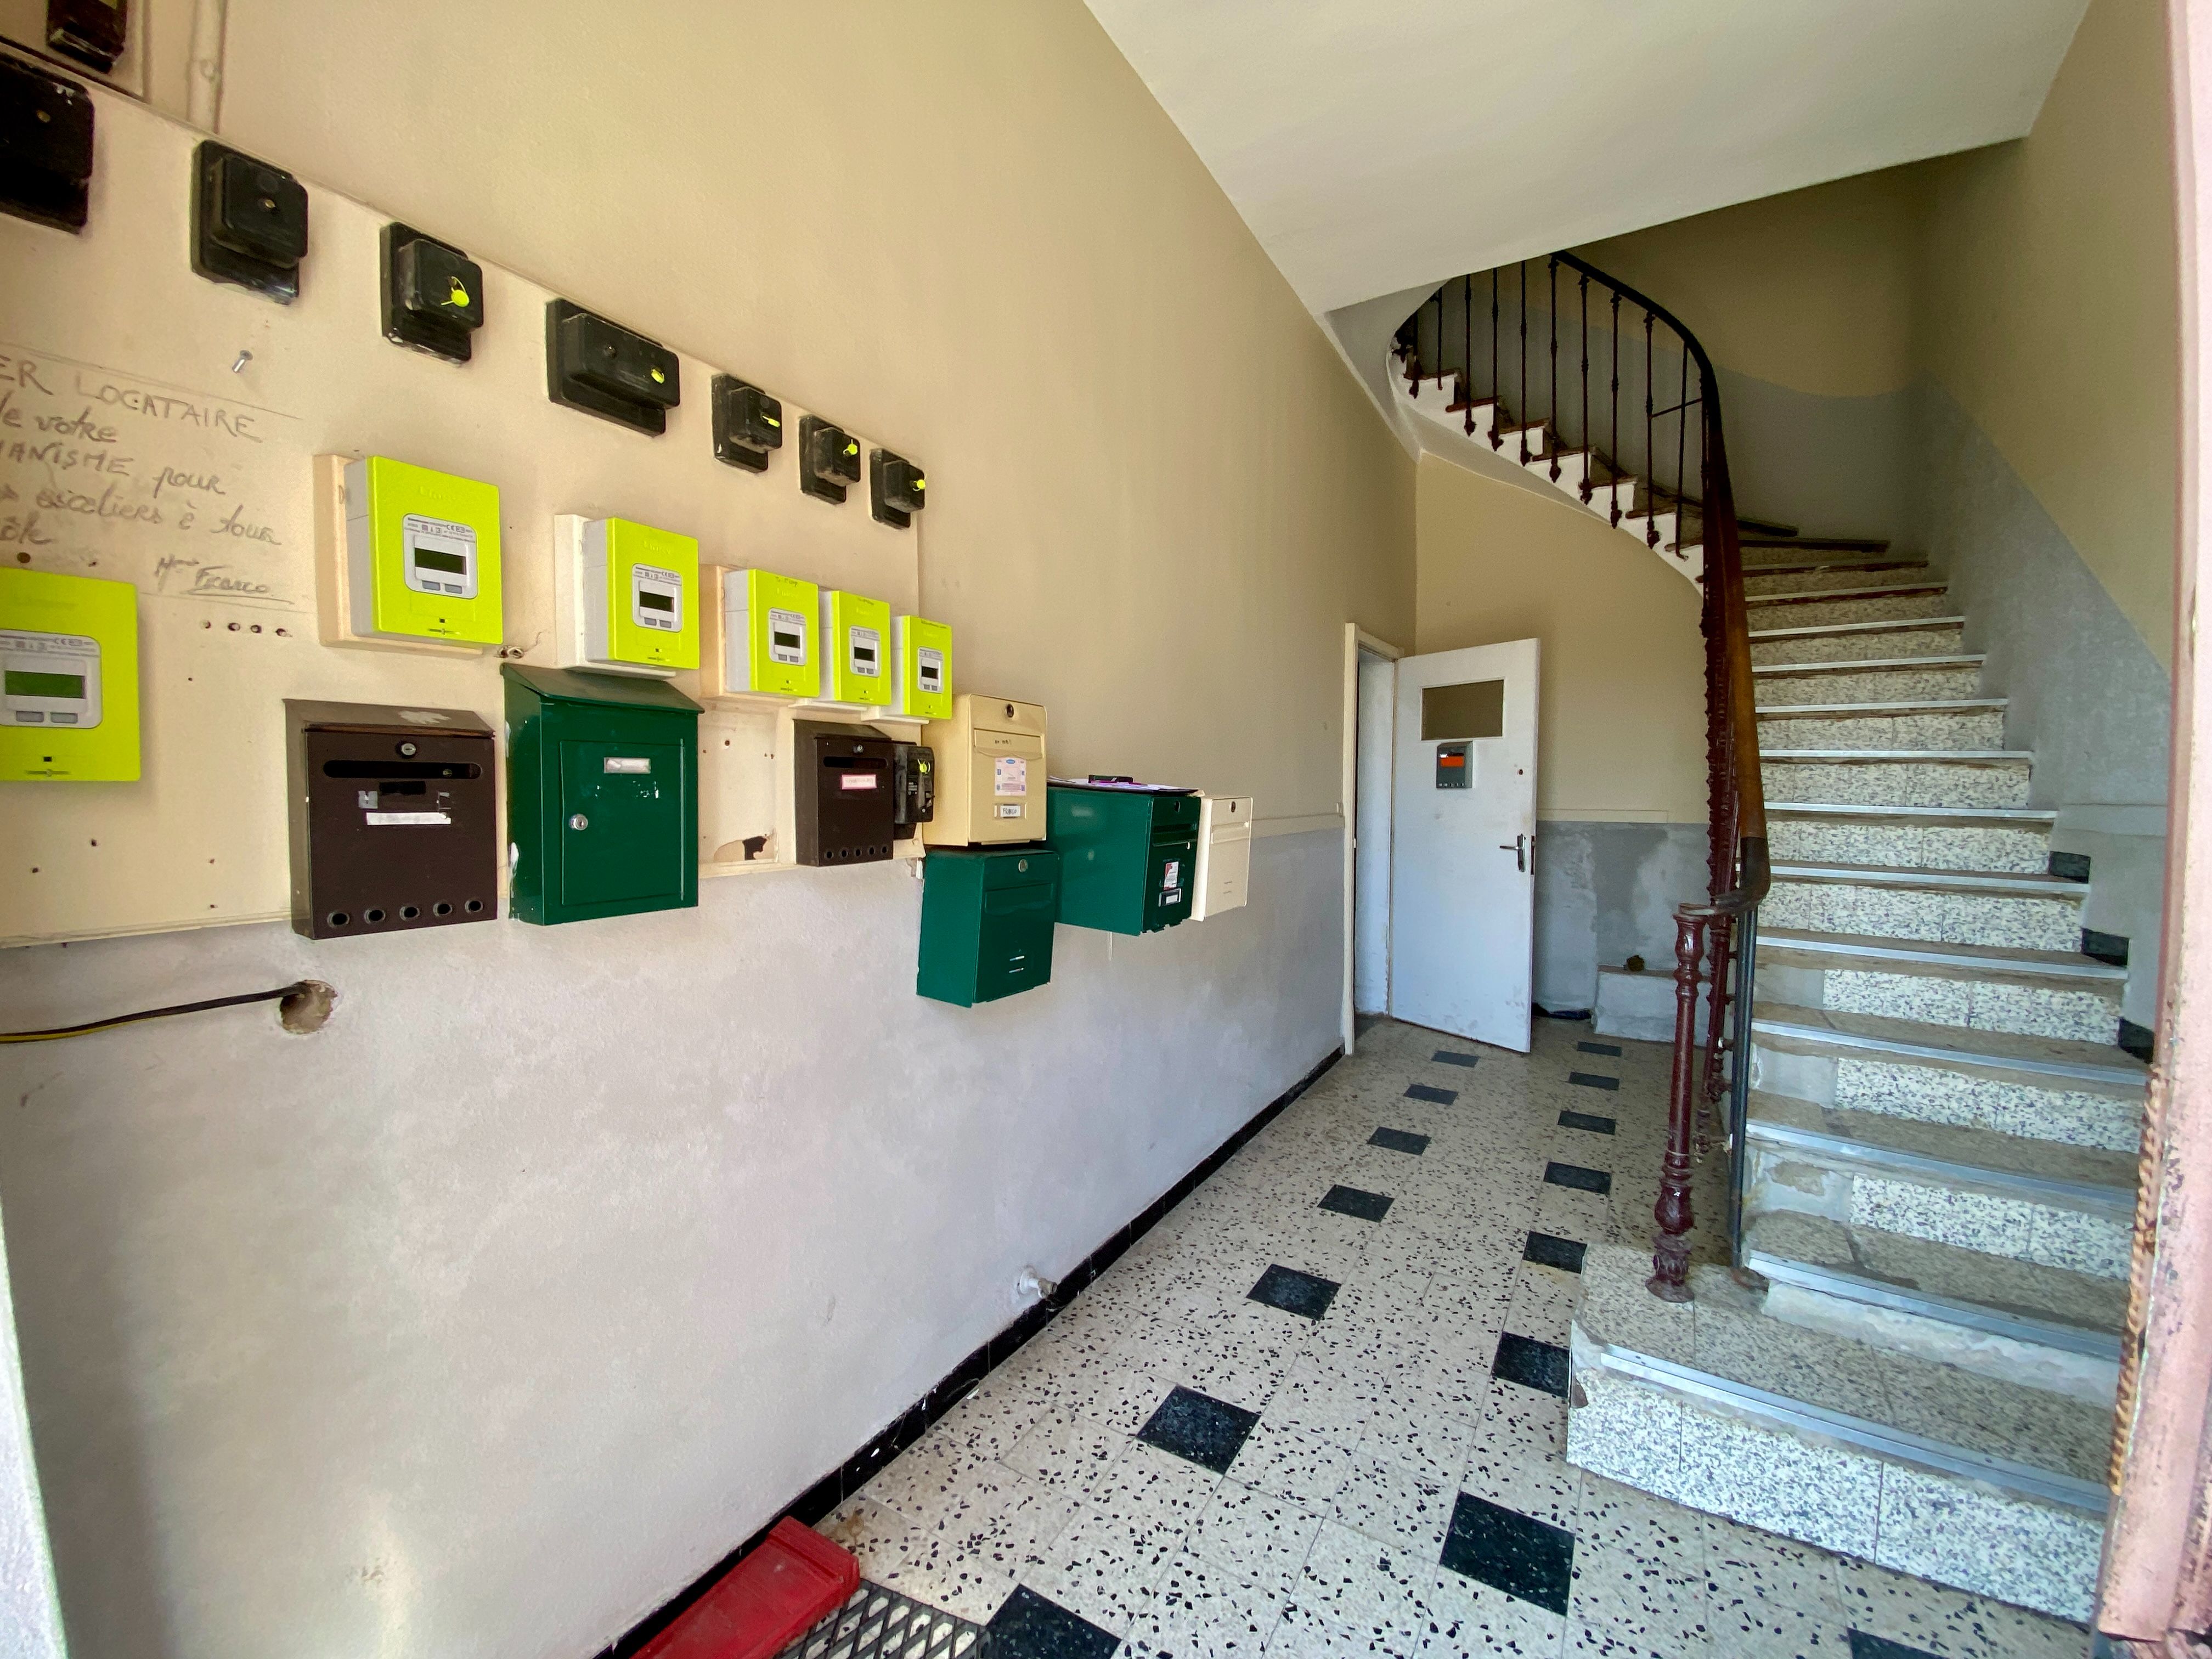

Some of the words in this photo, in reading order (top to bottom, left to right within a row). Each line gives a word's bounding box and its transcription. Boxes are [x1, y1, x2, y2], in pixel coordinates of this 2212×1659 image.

[35, 405, 117, 443] votre
[75, 370, 263, 443] LOCATAIRE
[152, 466, 226, 499] pour
[210, 503, 282, 545] tour
